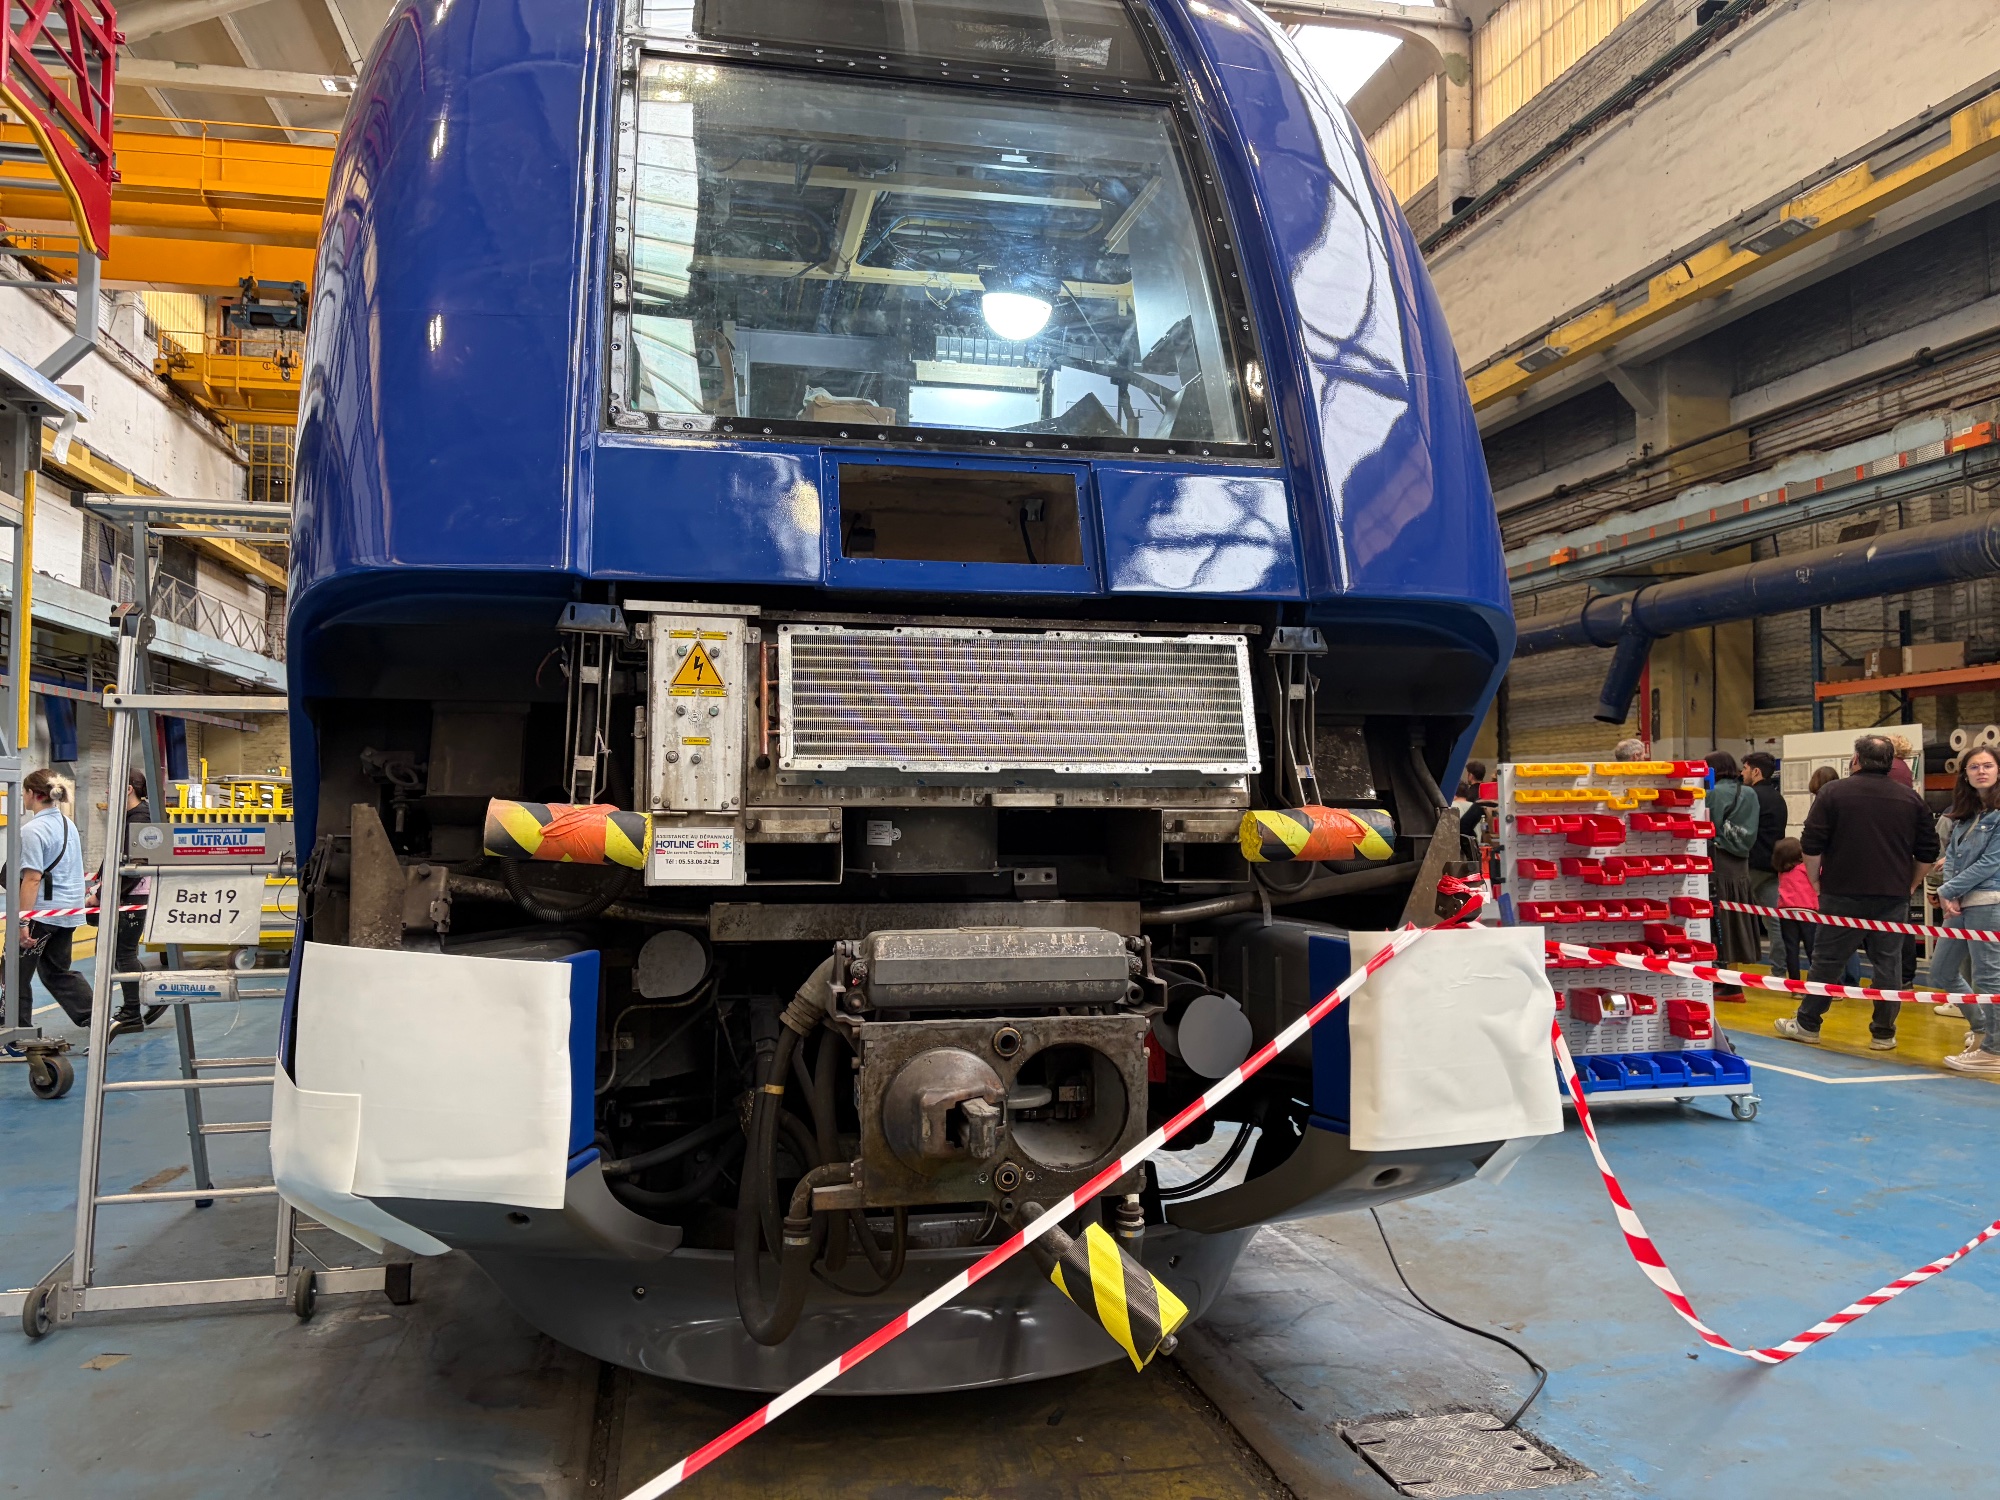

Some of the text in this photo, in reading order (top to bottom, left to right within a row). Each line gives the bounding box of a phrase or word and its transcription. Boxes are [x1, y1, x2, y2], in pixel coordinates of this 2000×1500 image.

[191, 834, 248, 846] ULTRALU
[656, 840, 719, 849] HOTLINE Clim
[176, 889, 238, 904] Bat 19
[167, 909, 240, 924] Stand 7
[170, 984, 206, 992] ULTRALU
